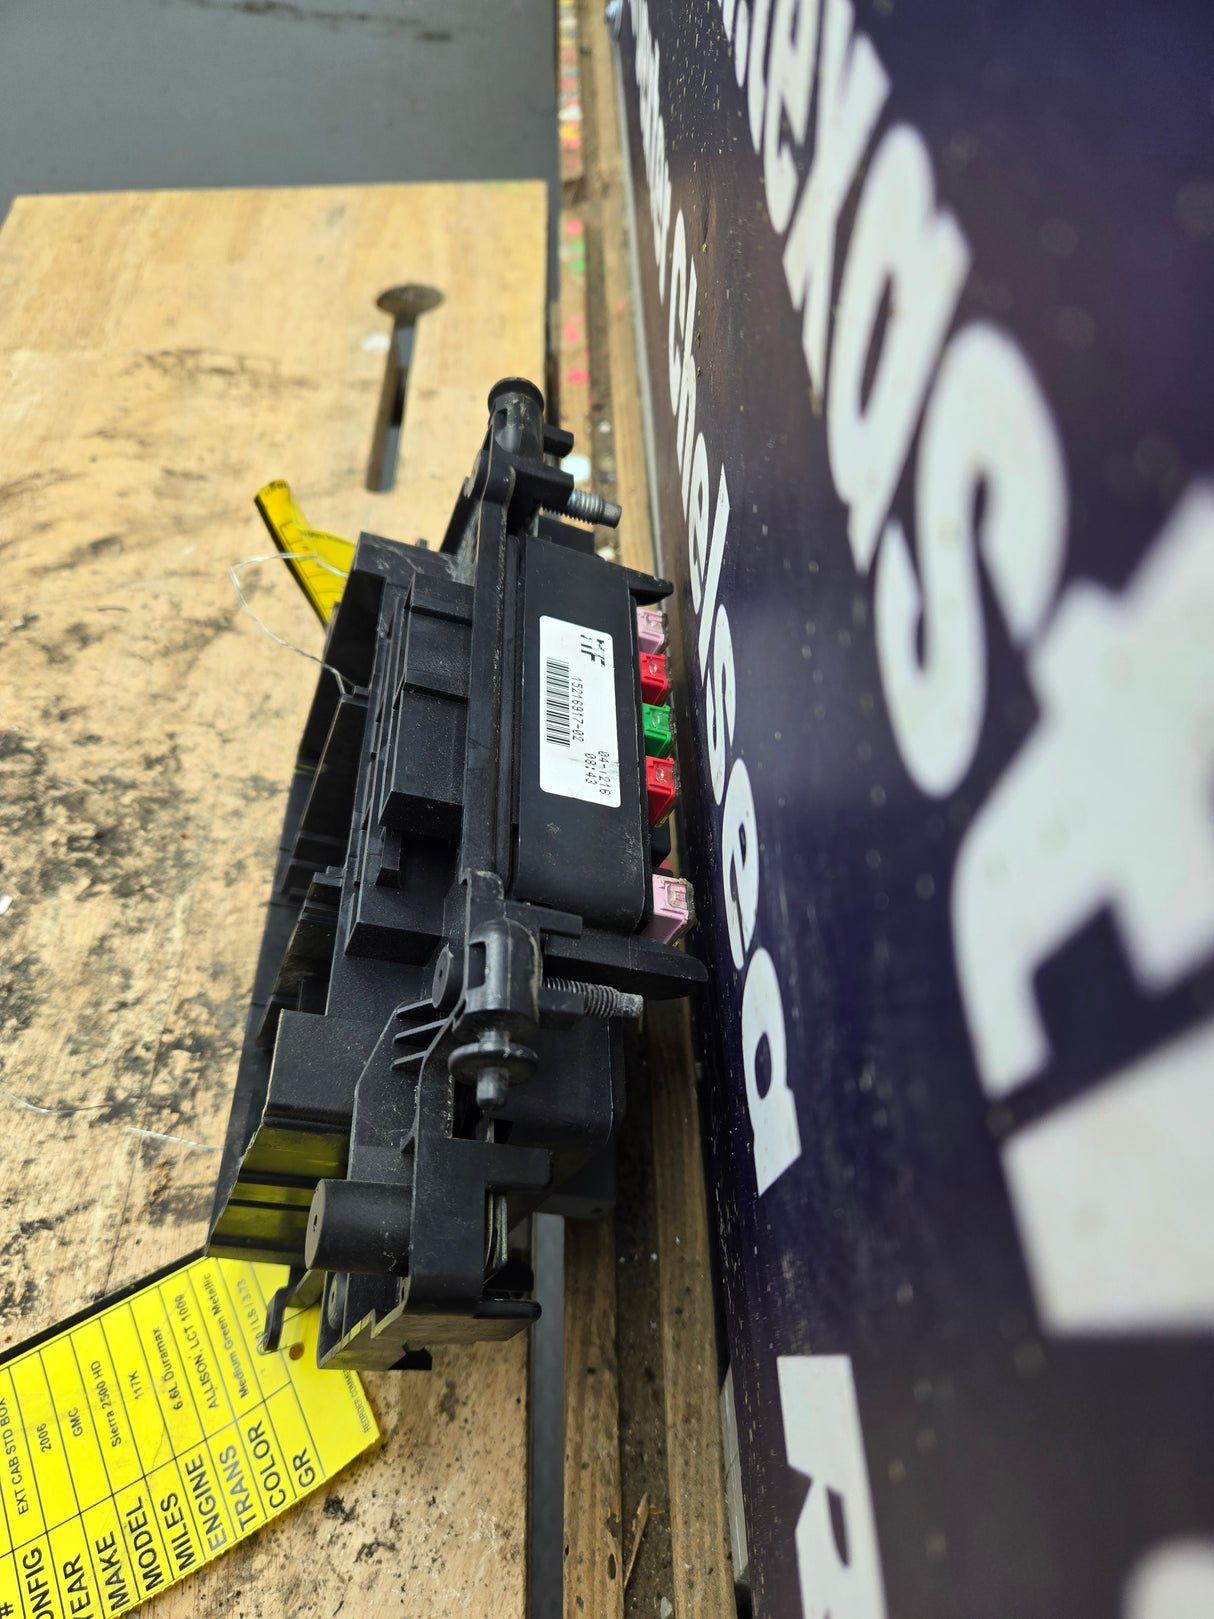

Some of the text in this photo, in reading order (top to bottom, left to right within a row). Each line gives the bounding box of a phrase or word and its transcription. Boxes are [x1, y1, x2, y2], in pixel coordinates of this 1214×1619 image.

[572, 677, 584, 743] 15216917-02
[585, 752, 598, 785] 08:43
[174, 1294, 191, 1322] 1000
[184, 1325, 200, 1350] LCT
[203, 1272, 250, 1399] Medium Green Metallic
[128, 1370, 144, 1400] 117K
[152, 1327, 184, 1411] 6.6L Duramax
[67, 1407, 84, 1438] GMC
[90, 1360, 122, 1448] Sierra 2500 HD
[2, 1428, 17, 1456] STD
[36, 1423, 52, 1453] 2006
[247, 1420, 287, 1509] COLOR
[8, 1456, 23, 1486] CAB
[219, 1445, 257, 1532] TRANS
[292, 1447, 316, 1488] GR
[14, 1488, 29, 1515] EXT
[185, 1453, 228, 1552] ENGINE
[125, 1496, 165, 1592] MODEL
[160, 1492, 197, 1572] MILES
[95, 1531, 130, 1612] MAKE
